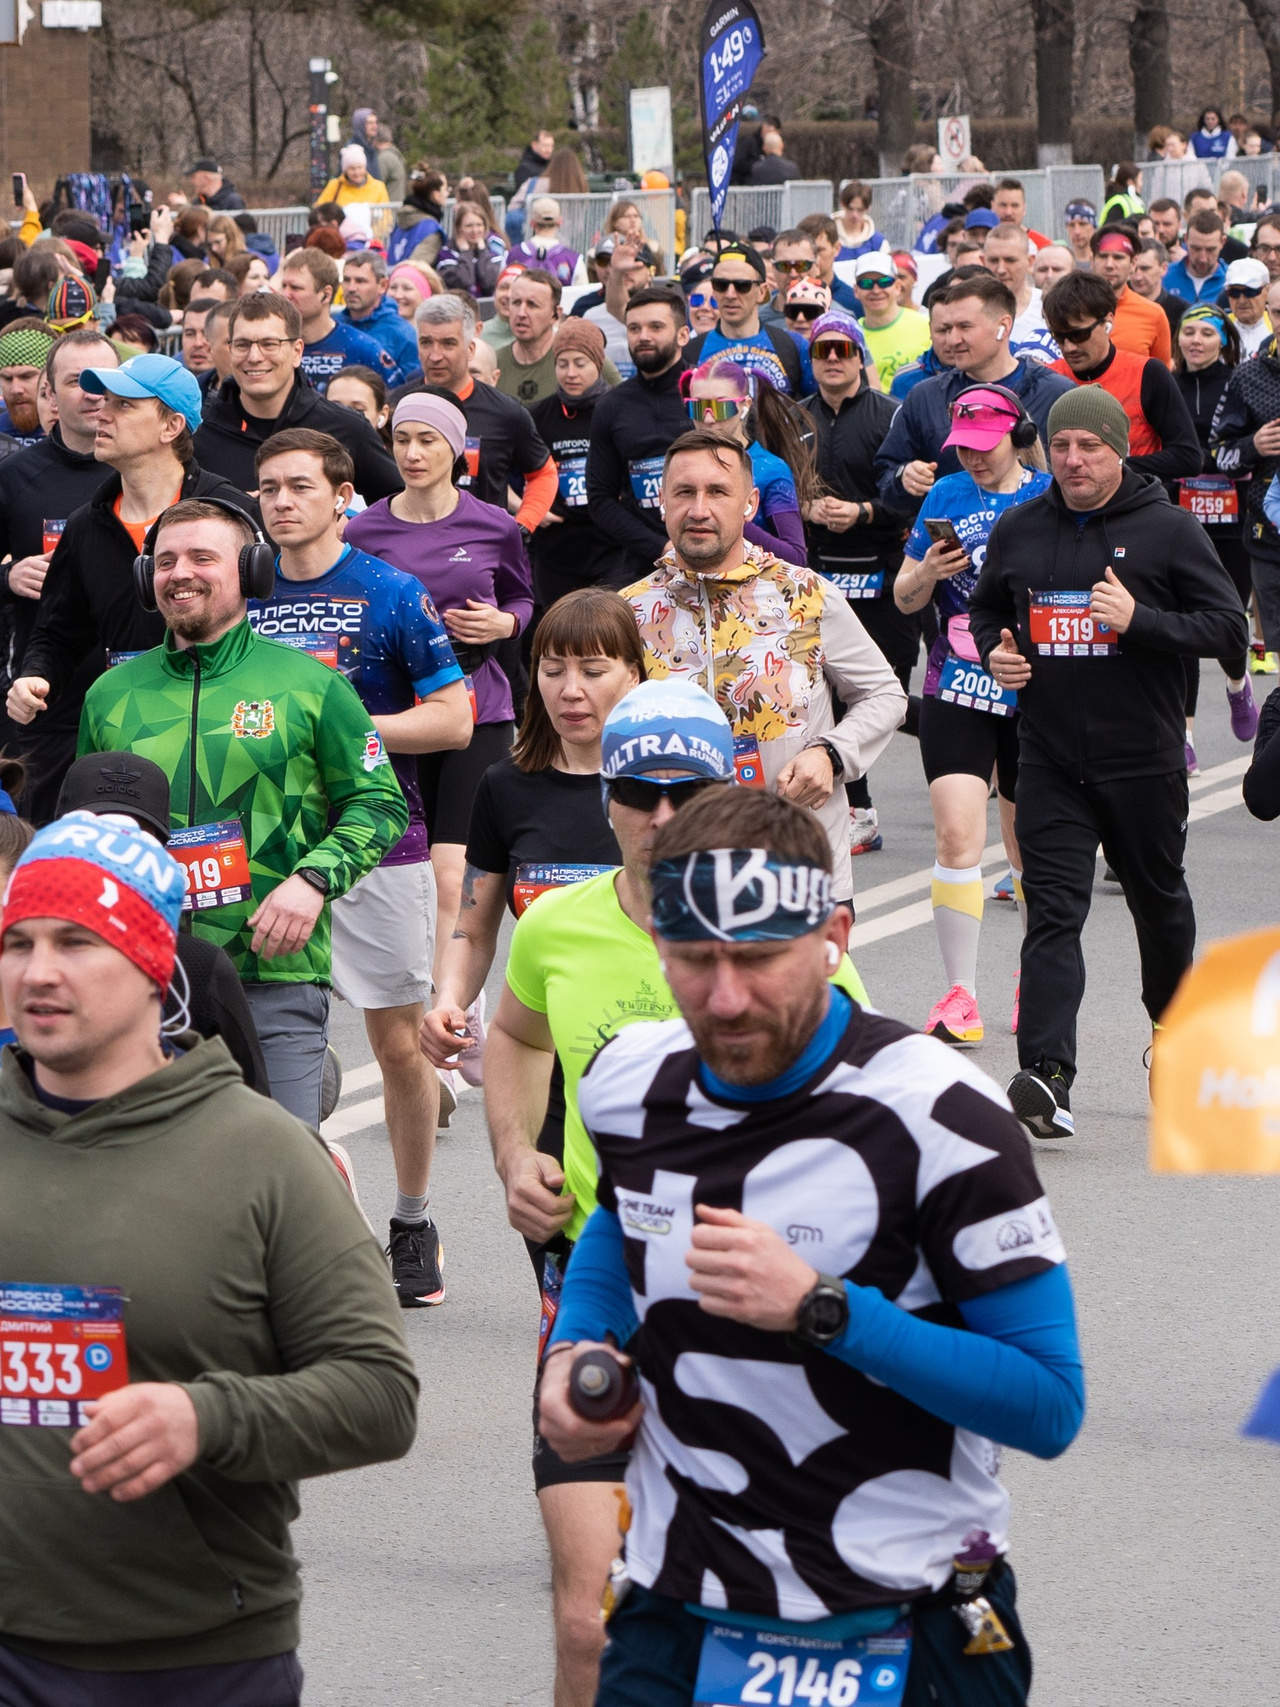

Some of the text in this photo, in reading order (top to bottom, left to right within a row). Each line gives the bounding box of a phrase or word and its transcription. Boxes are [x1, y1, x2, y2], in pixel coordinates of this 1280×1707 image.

[710, 7, 739, 38] GARMIN
[301, 356, 343, 364] ОСТО
[1190, 496, 1224, 514] 1259
[954, 511, 995, 533] РОСТО
[958, 524, 983, 540] МОС
[831, 573, 870, 588] 2297
[1048, 617, 1094, 641] 1319
[951, 668, 1003, 700] 2005
[606, 733, 688, 776] ULTRA
[744, 768, 753, 778] D
[95, 784, 142, 798] adidas
[167, 835, 207, 846] ОСМОС
[51, 825, 175, 893] RUN
[223, 856, 233, 866] E
[616, 1000, 673, 1013] NEW JERSEY
[0, 1320, 53, 1333] ДМИТРИЙ
[91, 1349, 108, 1365] D
[740, 1651, 896, 1707] 2146 D
